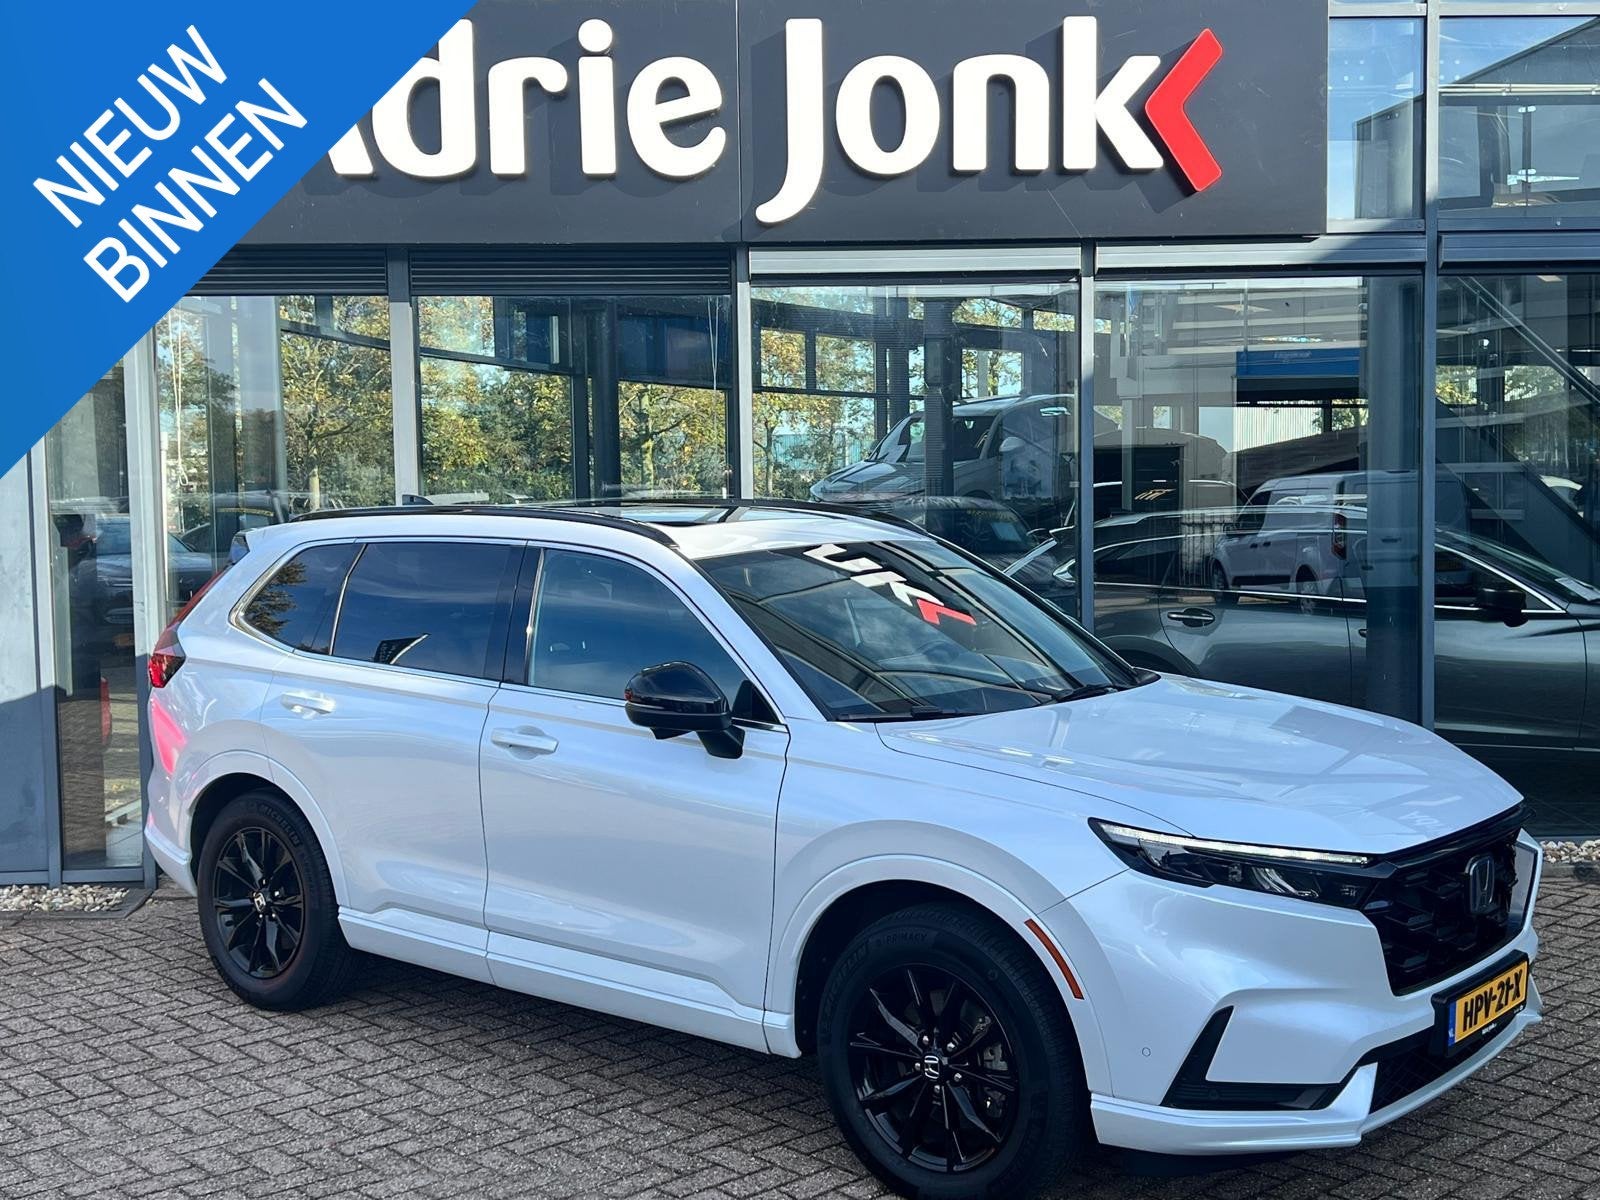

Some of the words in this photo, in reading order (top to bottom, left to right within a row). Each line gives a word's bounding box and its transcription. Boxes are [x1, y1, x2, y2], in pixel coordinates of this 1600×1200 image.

[327, 18, 727, 179] drie
[755, 15, 1165, 223] Jonk
[260, 805, 300, 845] MICHELIN
